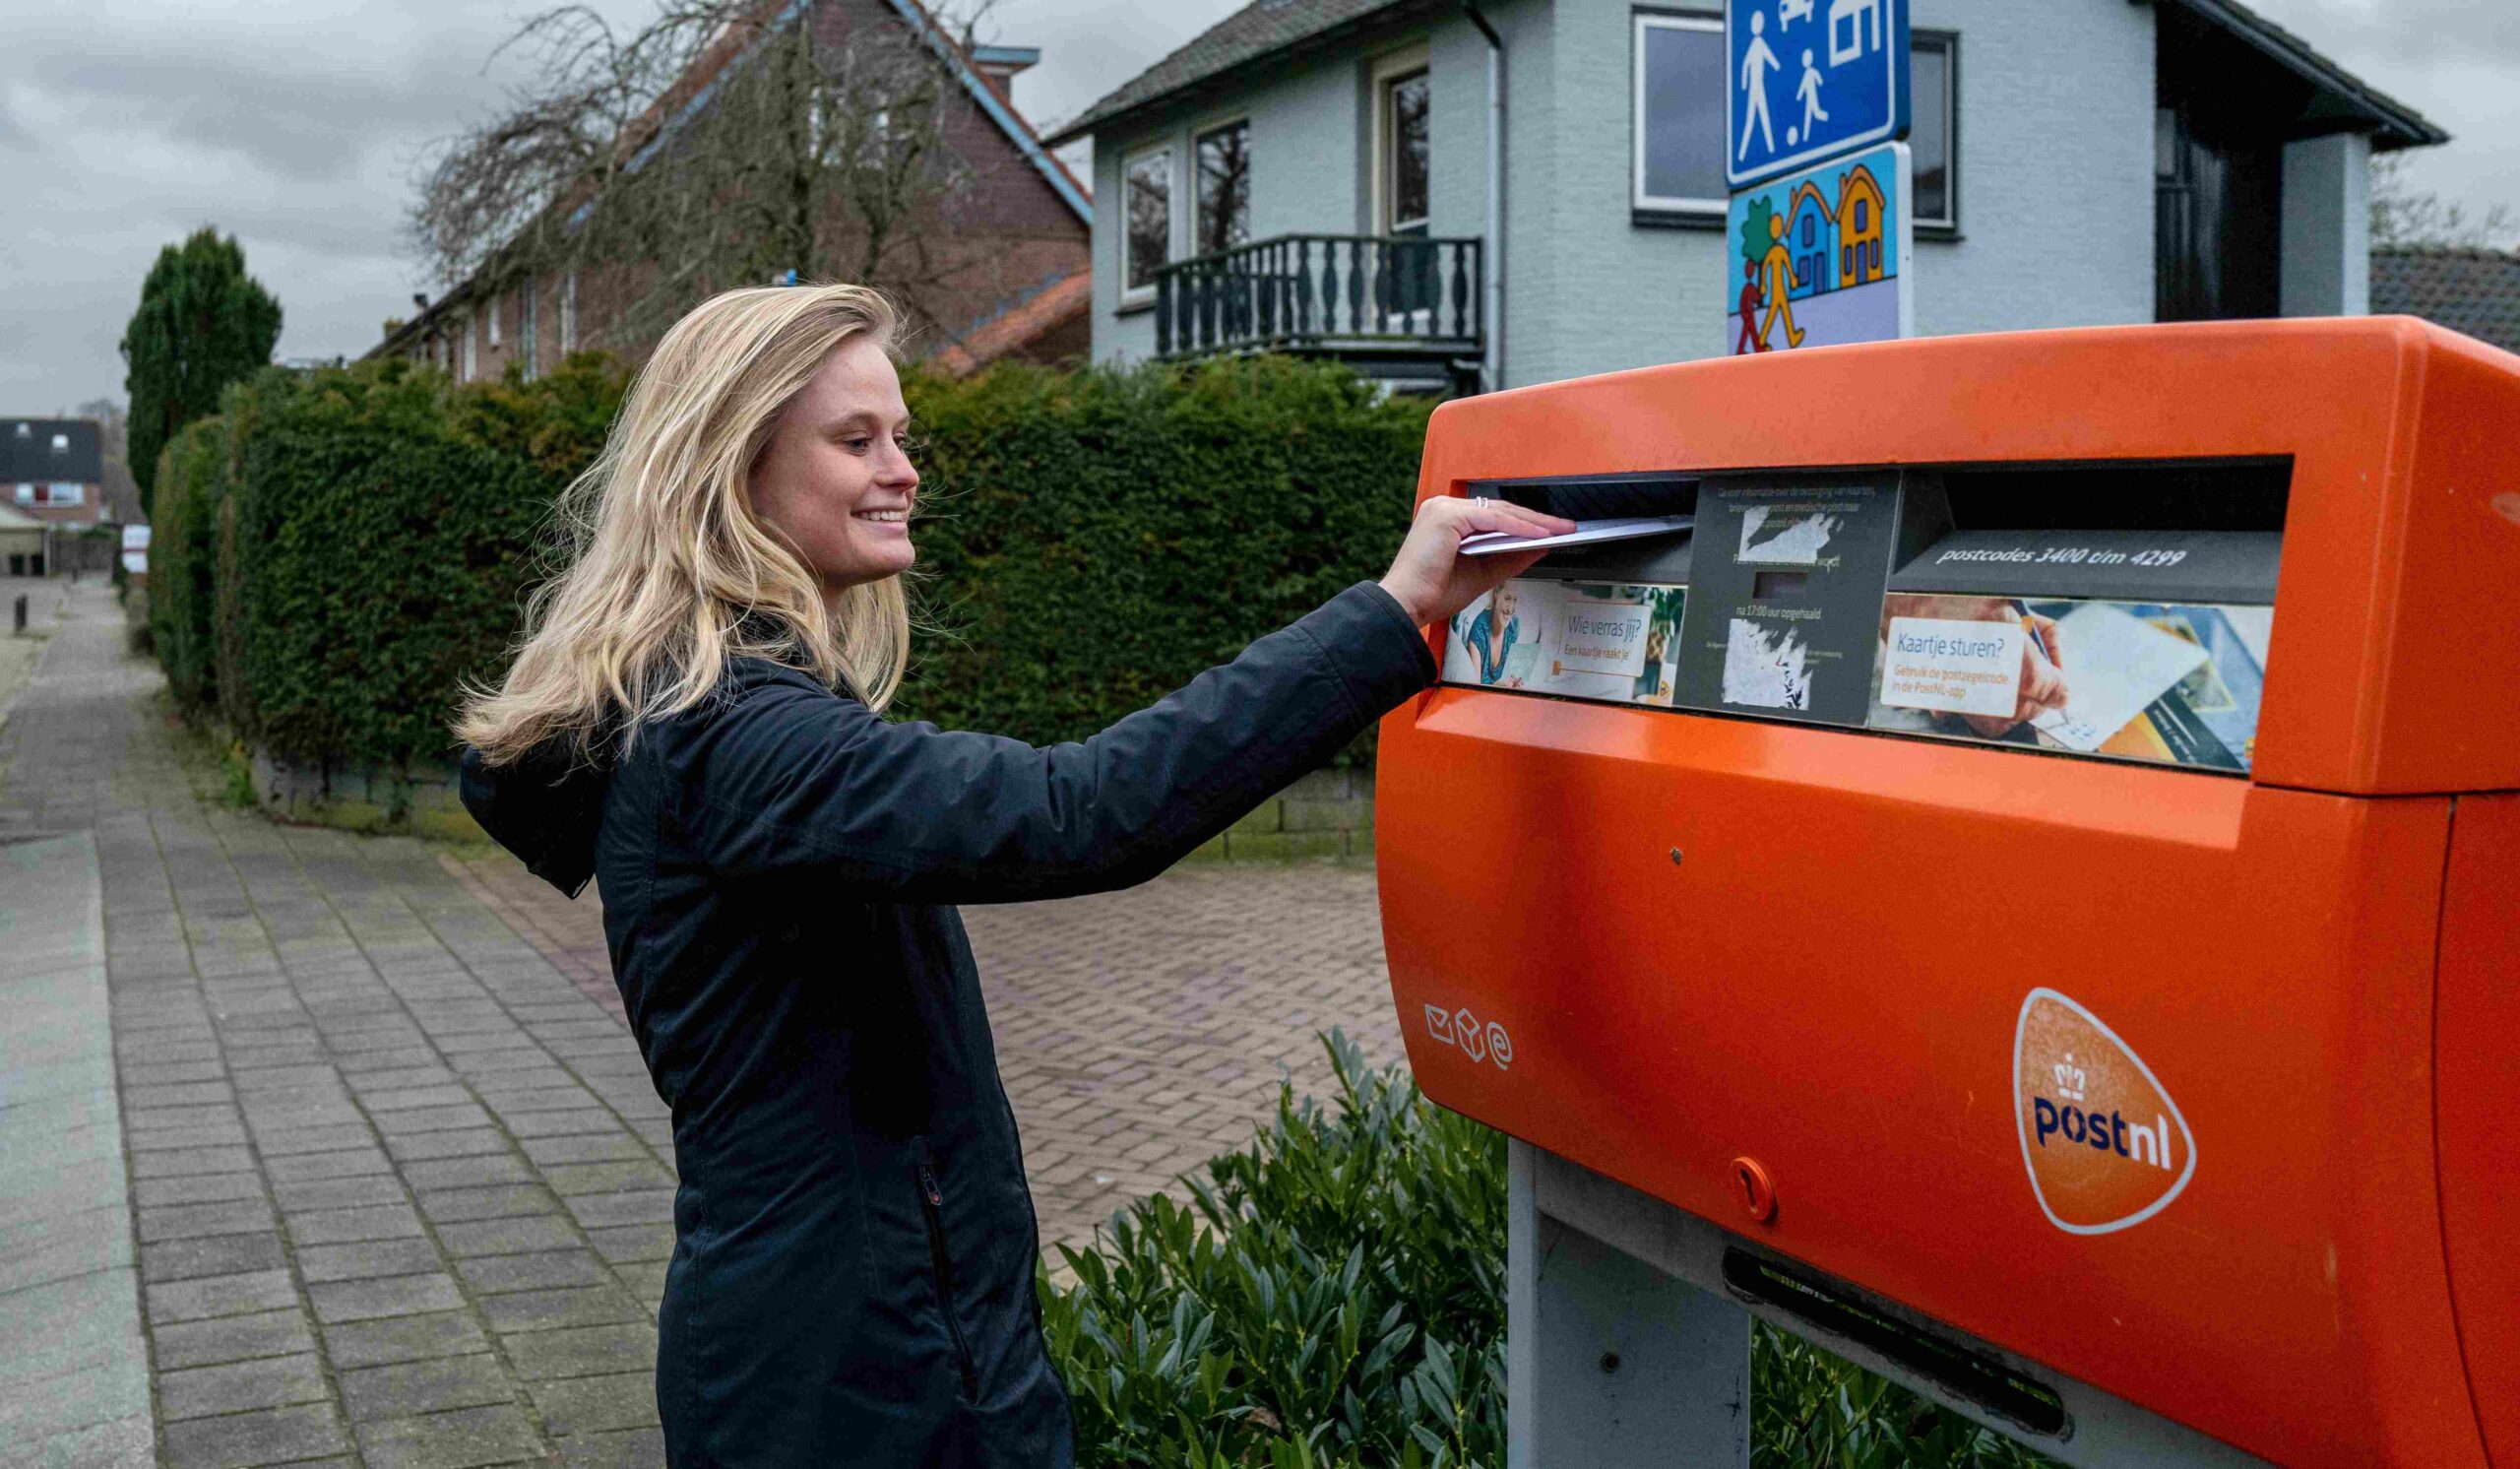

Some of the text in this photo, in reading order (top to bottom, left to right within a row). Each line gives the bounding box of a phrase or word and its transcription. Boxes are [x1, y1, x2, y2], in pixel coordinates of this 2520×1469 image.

[1935, 547, 2187, 566] postcodes 3400 t/m 4299
[1736, 605, 1822, 621] na 17:00 uur opgehaald
[1568, 615, 1642, 642] Wie verras jij?
[1564, 644, 1578, 656] Een
[1578, 645, 1602, 661] kaartje
[1603, 647, 1621, 660] raakt
[1897, 632, 2005, 659] Kaartje sturen?
[1894, 664, 2009, 686] Gebruik de postzegelcode
[1892, 678, 1901, 691] in
[1901, 679, 1913, 693] de
[2034, 1097, 2172, 1171] postnl
